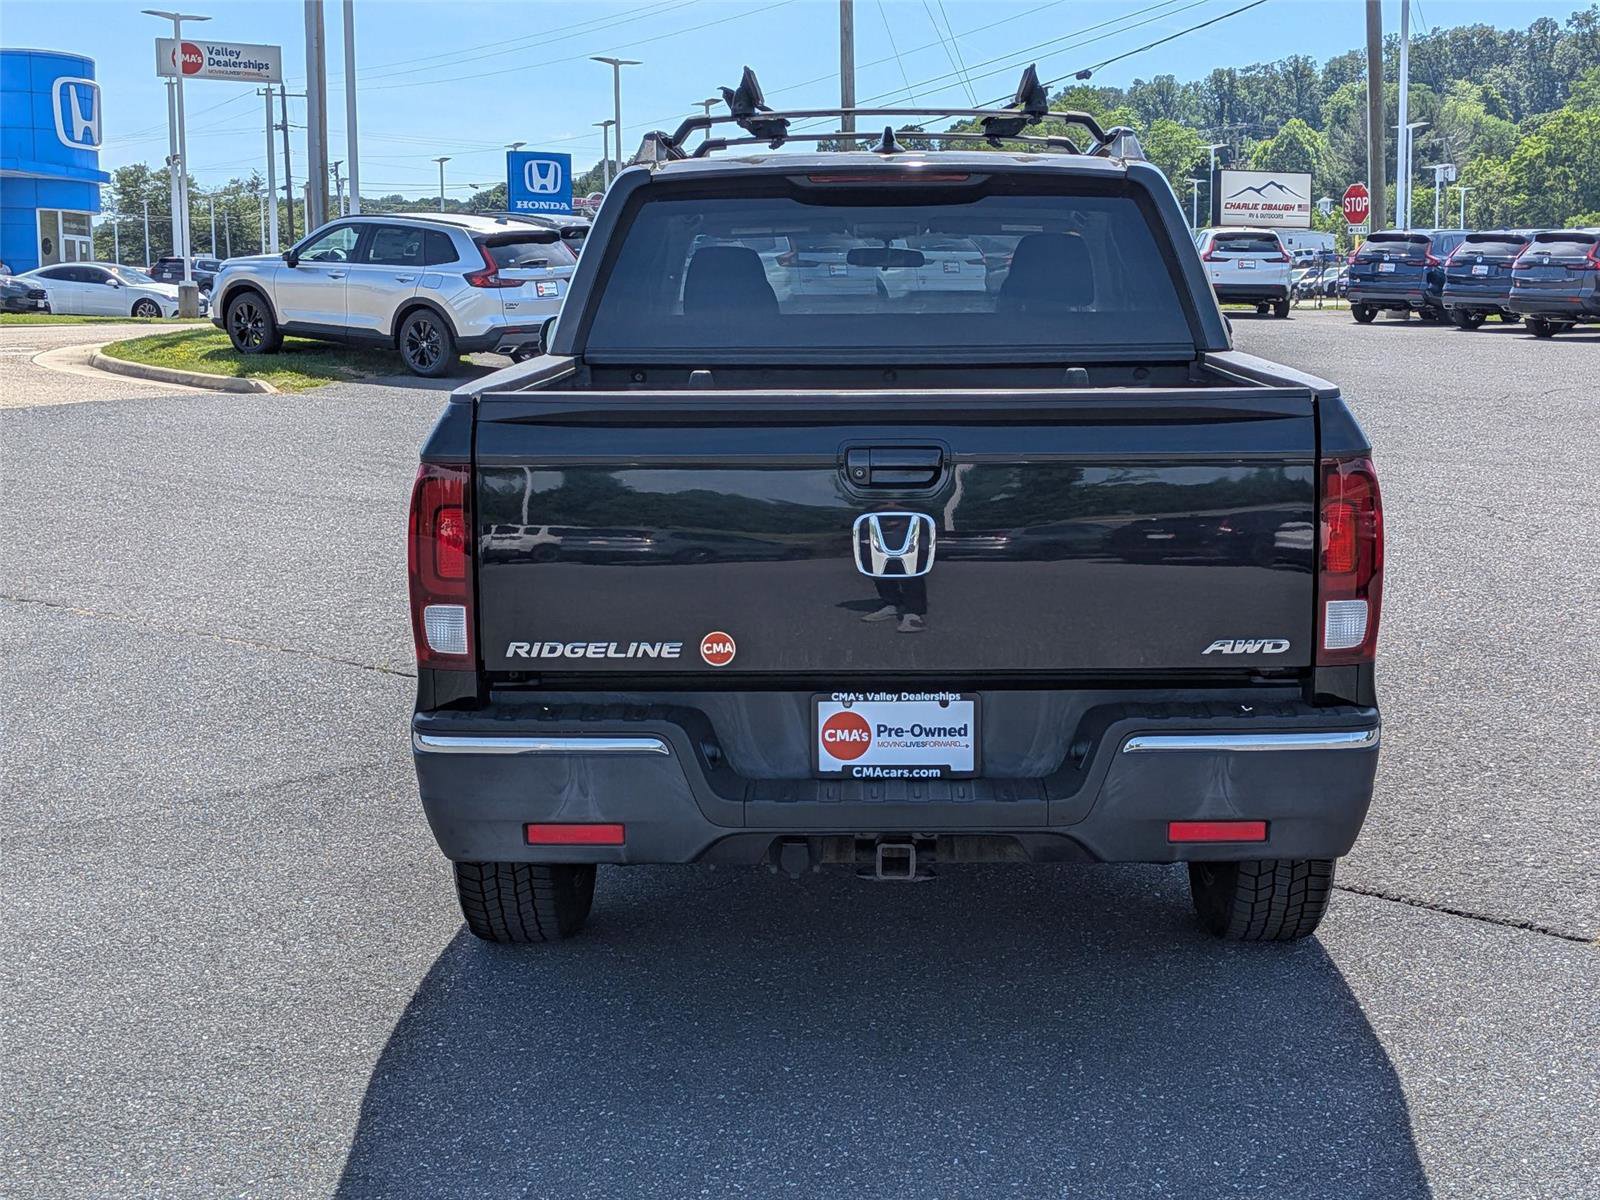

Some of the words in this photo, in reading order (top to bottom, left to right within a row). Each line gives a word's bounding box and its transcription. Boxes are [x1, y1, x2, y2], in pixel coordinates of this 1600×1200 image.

[207, 46, 241, 58] Valley
[207, 57, 270, 72] Dealerships
[516, 200, 571, 211] HONDA
[1224, 202, 1260, 211] CHARLIE
[1261, 203, 1296, 212] OBAUGH
[1344, 196, 1369, 213] STOP
[506, 642, 683, 658] RIDGELINE
[703, 643, 733, 654] CMA
[1201, 639, 1291, 655] AWD
[831, 692, 864, 701] CMA's
[866, 692, 899, 702] Valley
[901, 692, 961, 702] Dealerships
[824, 728, 870, 742] CMA's
[876, 723, 969, 738] Pre-Owned
[852, 766, 941, 778] CMAcars.com
